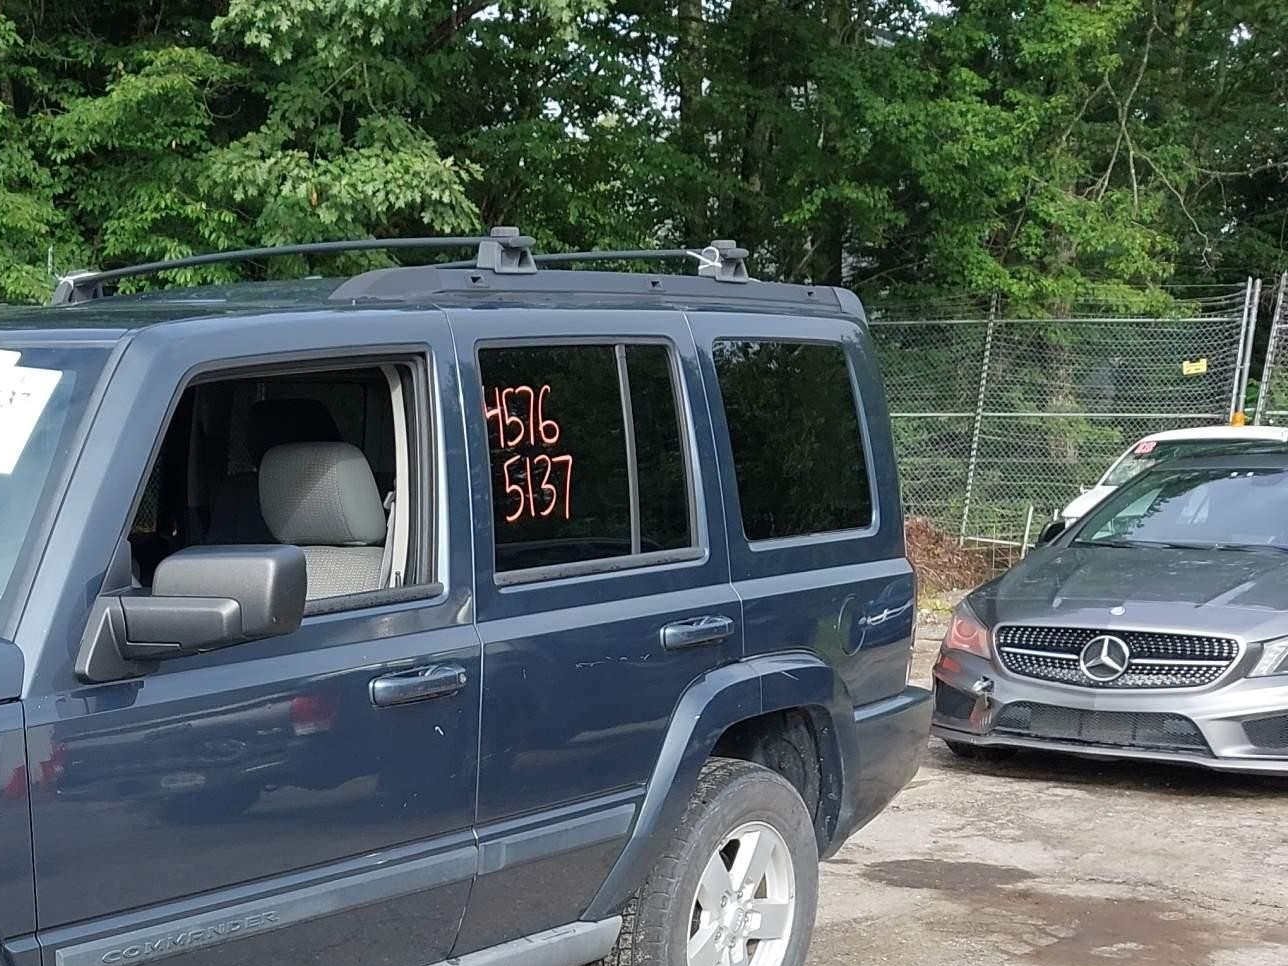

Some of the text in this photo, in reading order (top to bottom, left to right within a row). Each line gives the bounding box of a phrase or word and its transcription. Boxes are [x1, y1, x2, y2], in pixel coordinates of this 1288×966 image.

[481, 384, 560, 449] 4576
[503, 454, 574, 522] 5137
[101, 910, 281, 964] COMMANDER
